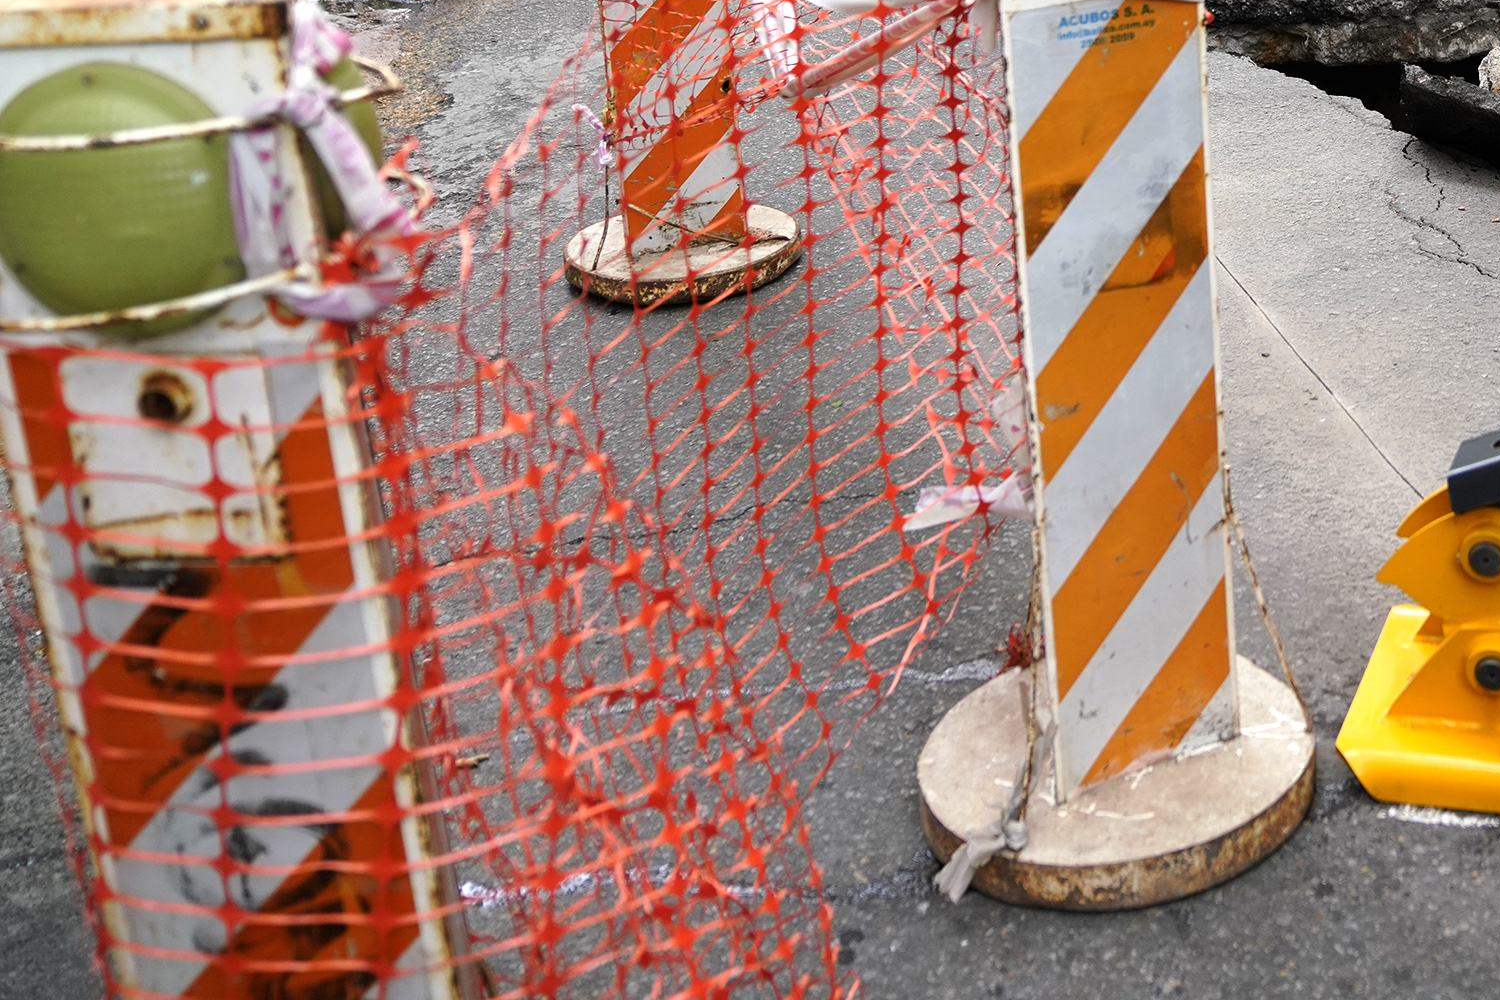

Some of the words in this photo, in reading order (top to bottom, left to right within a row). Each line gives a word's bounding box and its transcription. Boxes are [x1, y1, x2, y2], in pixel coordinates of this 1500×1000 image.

[1058, 8, 1120, 28] ACUBOS
[1123, 6, 1138, 18] S.
[1141, 3, 1155, 15] A.
